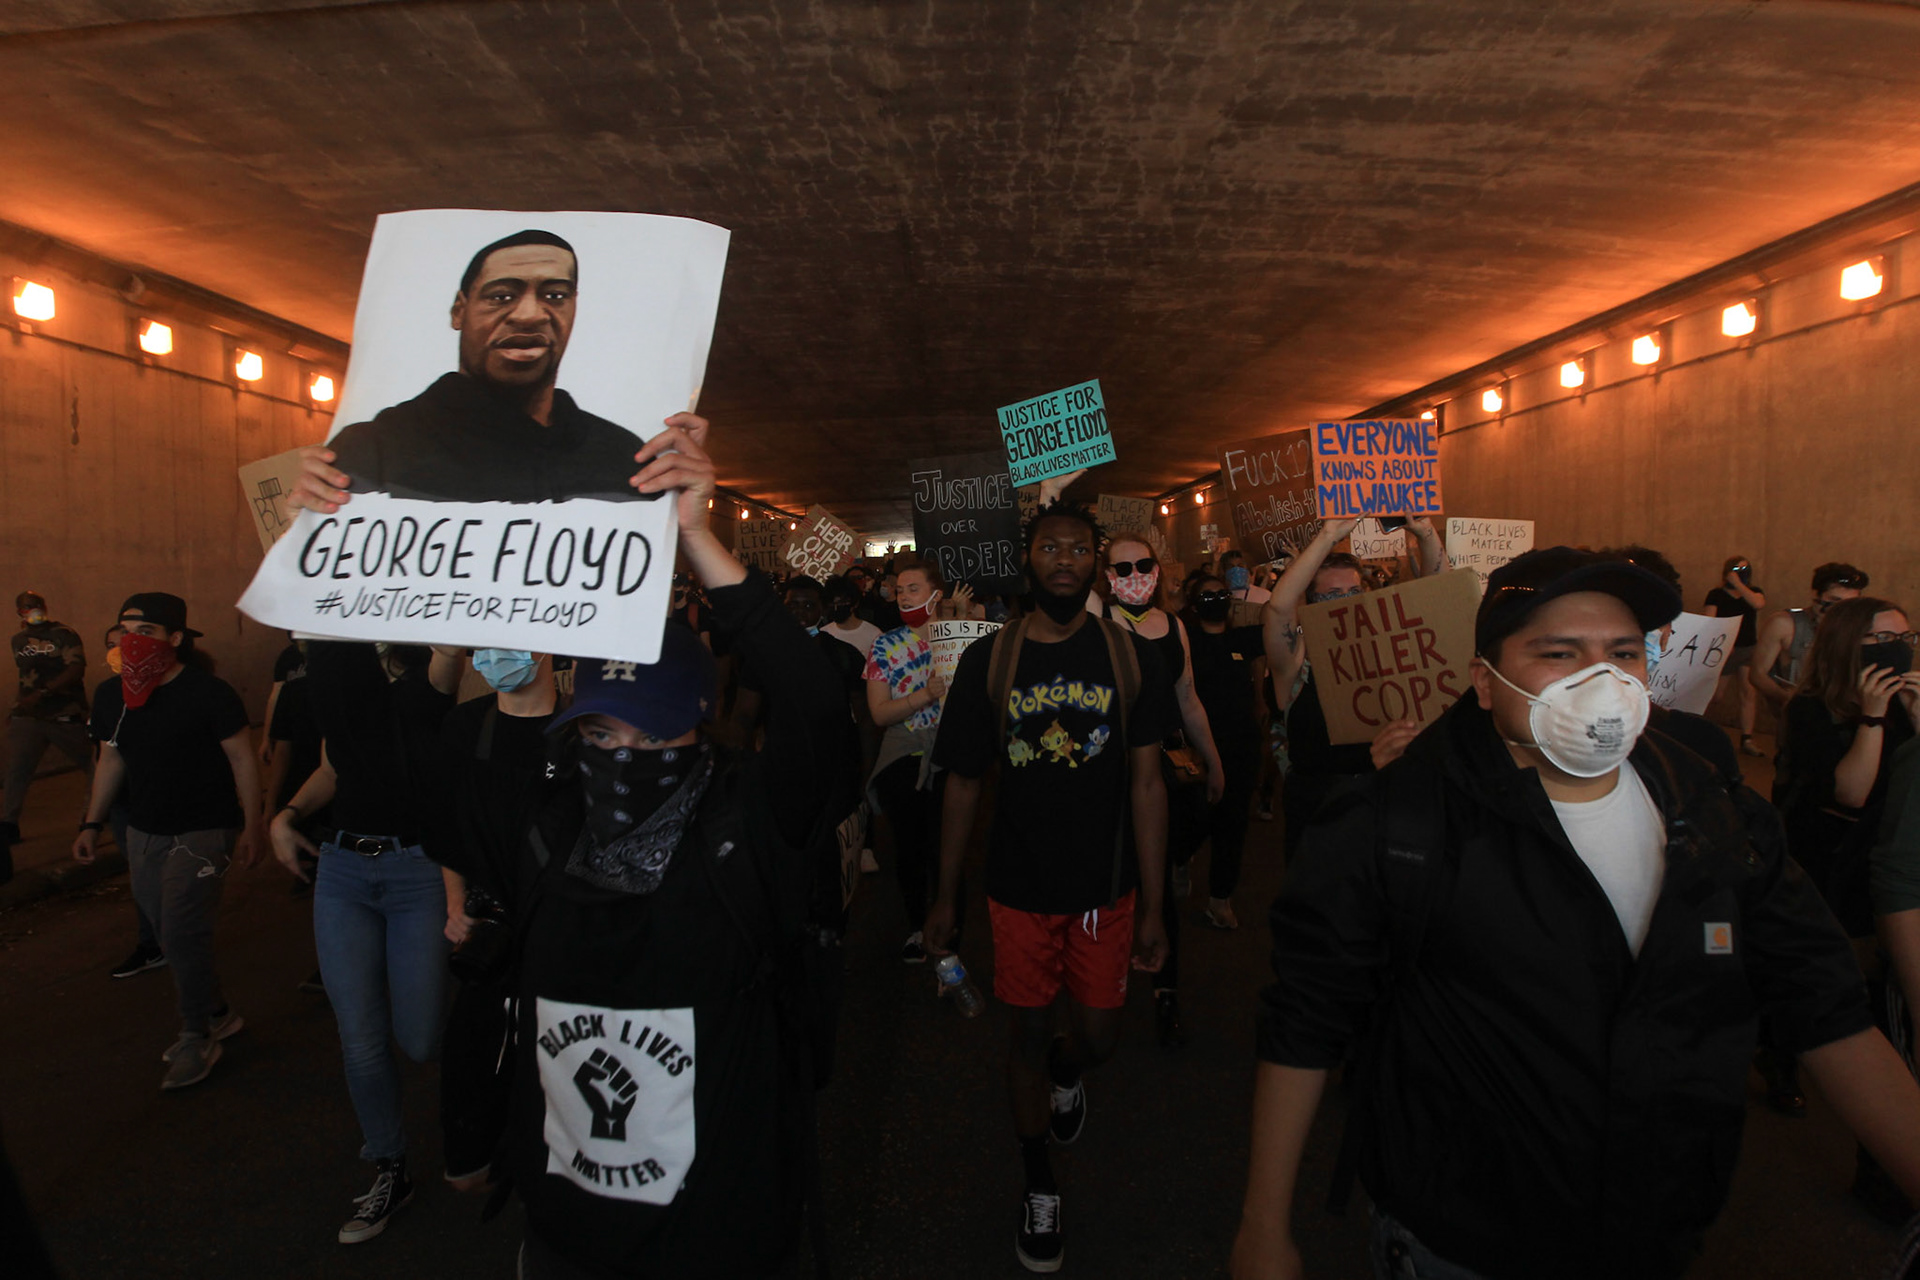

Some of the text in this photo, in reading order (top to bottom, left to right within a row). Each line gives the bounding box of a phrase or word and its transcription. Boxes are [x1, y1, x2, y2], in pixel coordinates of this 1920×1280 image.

[1001, 386, 1097, 430] JUSTICE FOR
[1004, 408, 1110, 463] GEORGE FLOYD
[1317, 421, 1438, 456] EVERYONE
[1010, 442, 1111, 483] BLACK LIVES MATTER
[1225, 449, 1288, 491] FUCK
[1321, 459, 1437, 481] KNOWS ABOUT
[912, 469, 1012, 513] JUSTICE
[1100, 496, 1148, 515] BLACK
[1318, 481, 1440, 516] MILWAUKEE
[741, 520, 788, 534] BLACK
[941, 519, 979, 535] OVER
[1236, 490, 1304, 537] Abolish
[1452, 520, 1527, 539] BLACK LIVES
[803, 535, 841, 573] OUR
[813, 516, 853, 555] HEAR
[1471, 538, 1513, 550] MATTER
[298, 516, 652, 596] GEORGE FLOYD
[740, 549, 788, 568] MATTE
[1449, 553, 1481, 567] WHITE
[929, 623, 952, 639] THIS
[960, 622, 970, 633] IS
[1329, 593, 1424, 641] JAIL
[1328, 628, 1448, 685] KILLER
[1352, 670, 1462, 726] COPS
[539, 1014, 692, 1077] BLACK LIVES
[572, 1149, 666, 1188] MATTER
